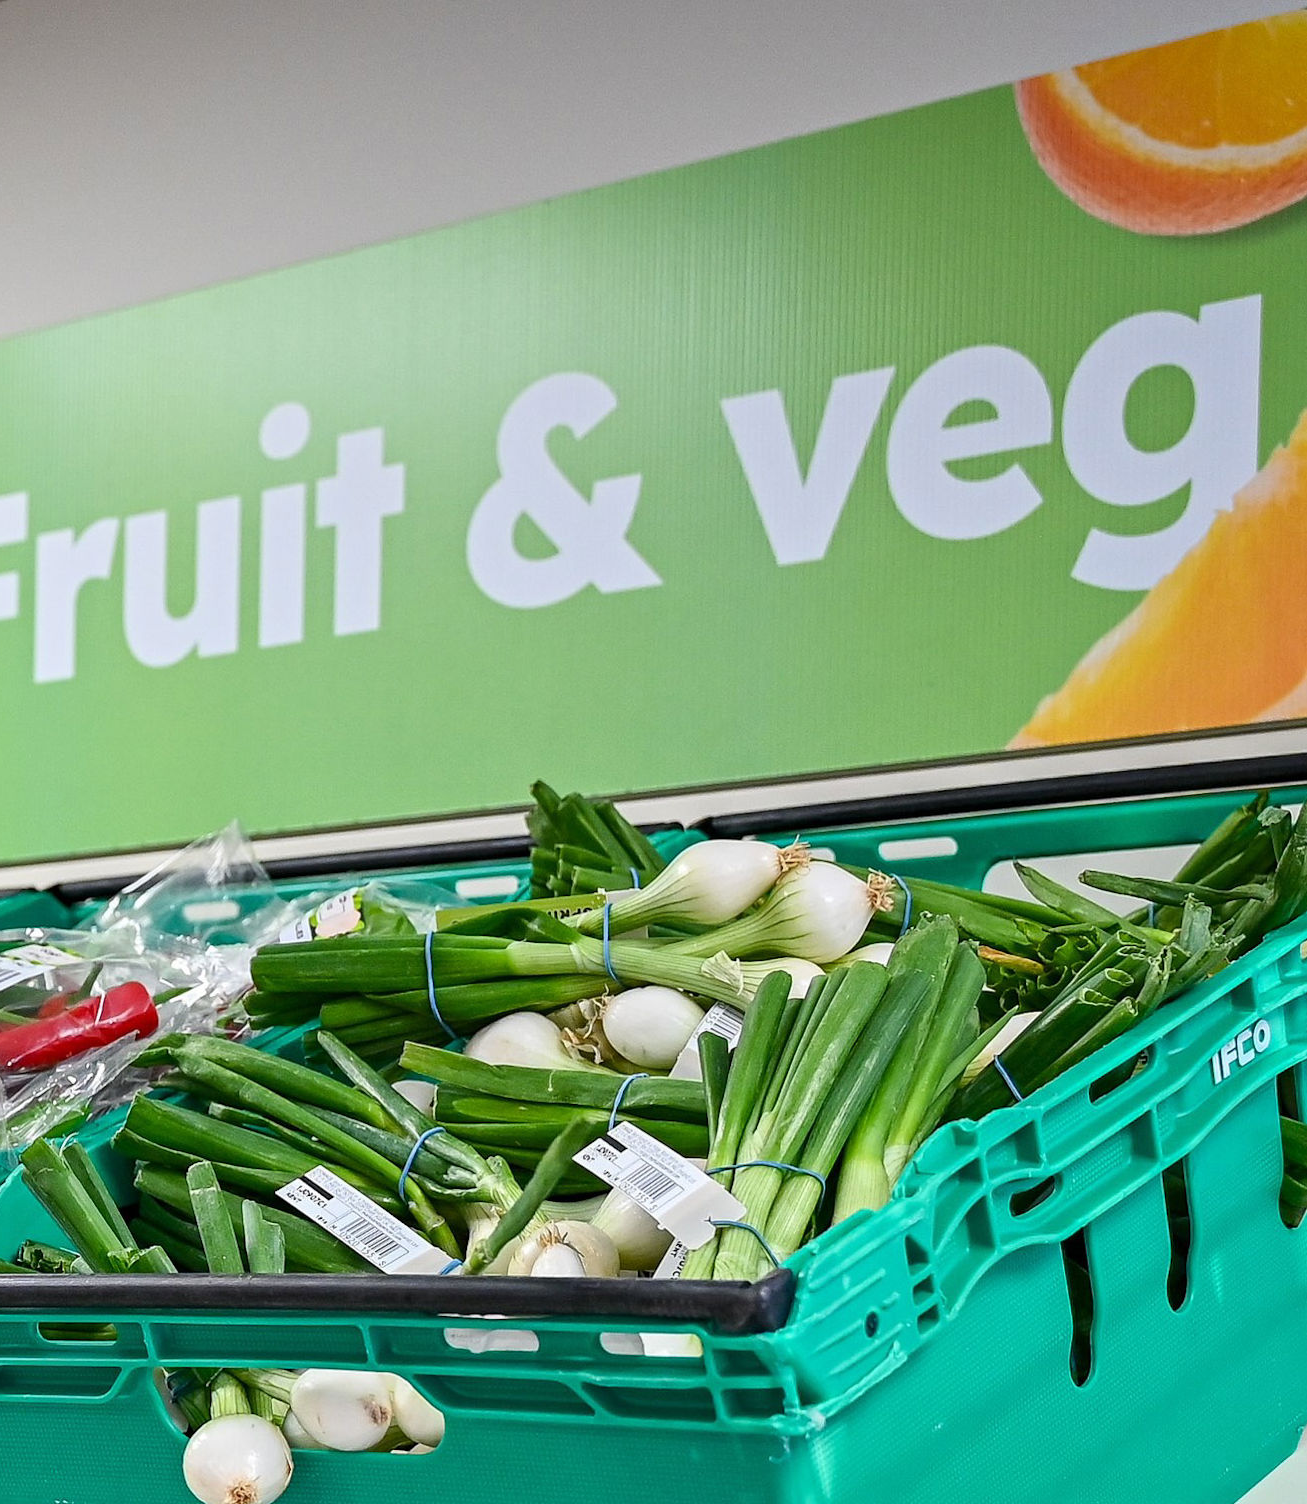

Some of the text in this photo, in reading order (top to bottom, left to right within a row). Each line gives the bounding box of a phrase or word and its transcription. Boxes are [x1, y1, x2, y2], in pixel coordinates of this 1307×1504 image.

[466, 371, 663, 611] &
[720, 293, 1262, 592] veg
[1212, 1019, 1270, 1085] IFCO
